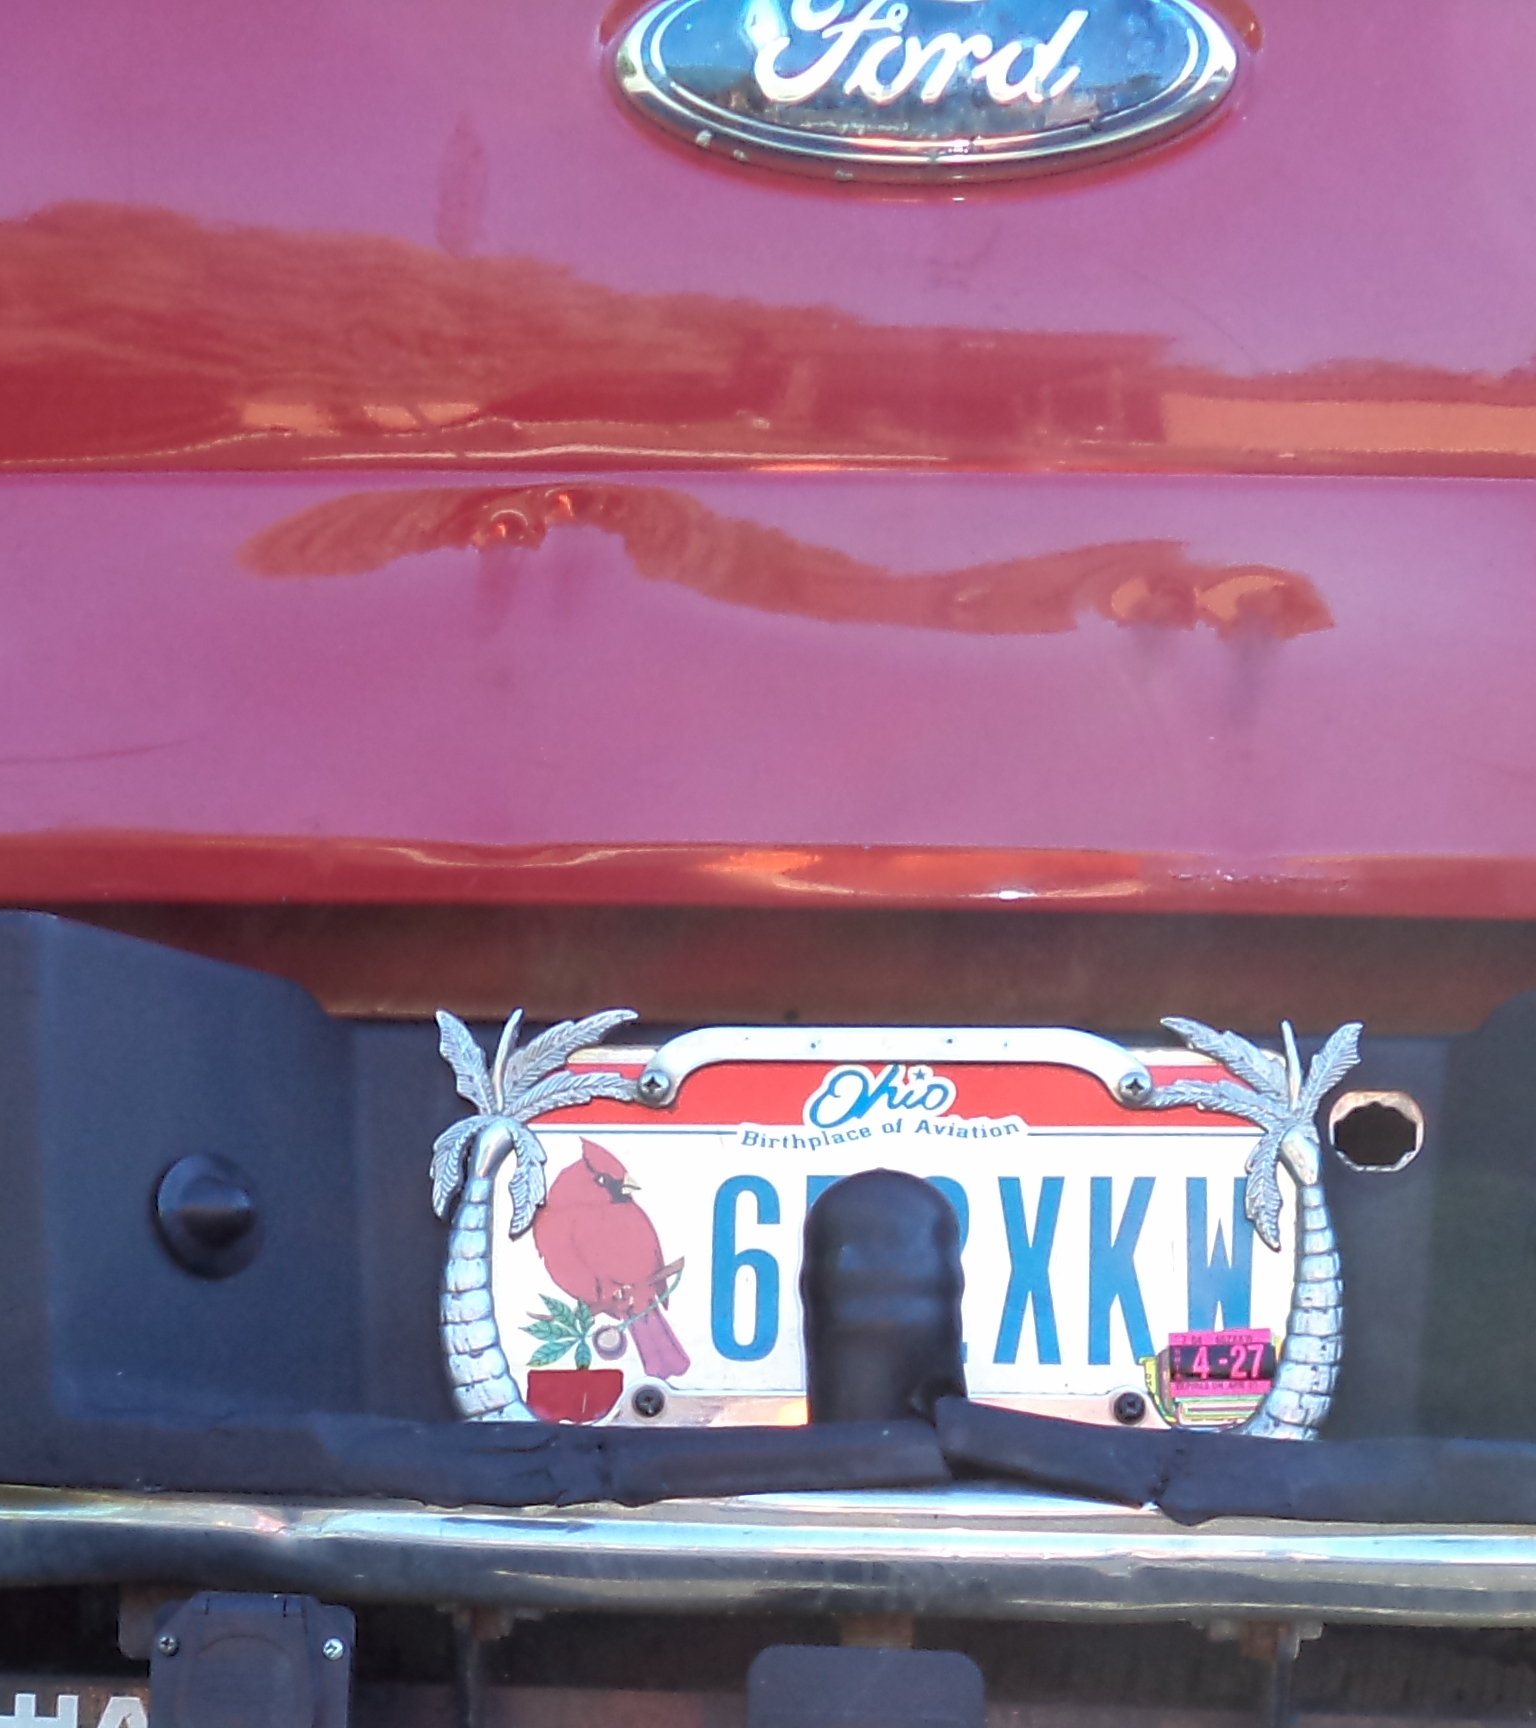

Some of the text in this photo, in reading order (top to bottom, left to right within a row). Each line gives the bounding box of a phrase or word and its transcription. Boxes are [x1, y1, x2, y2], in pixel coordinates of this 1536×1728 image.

[747, 0, 1090, 102] Ford
[740, 1118, 1020, 1151] Birthplace of Aviation
[809, 1065, 950, 1129] Ohio
[710, 1174, 1255, 1366] 6XKW
